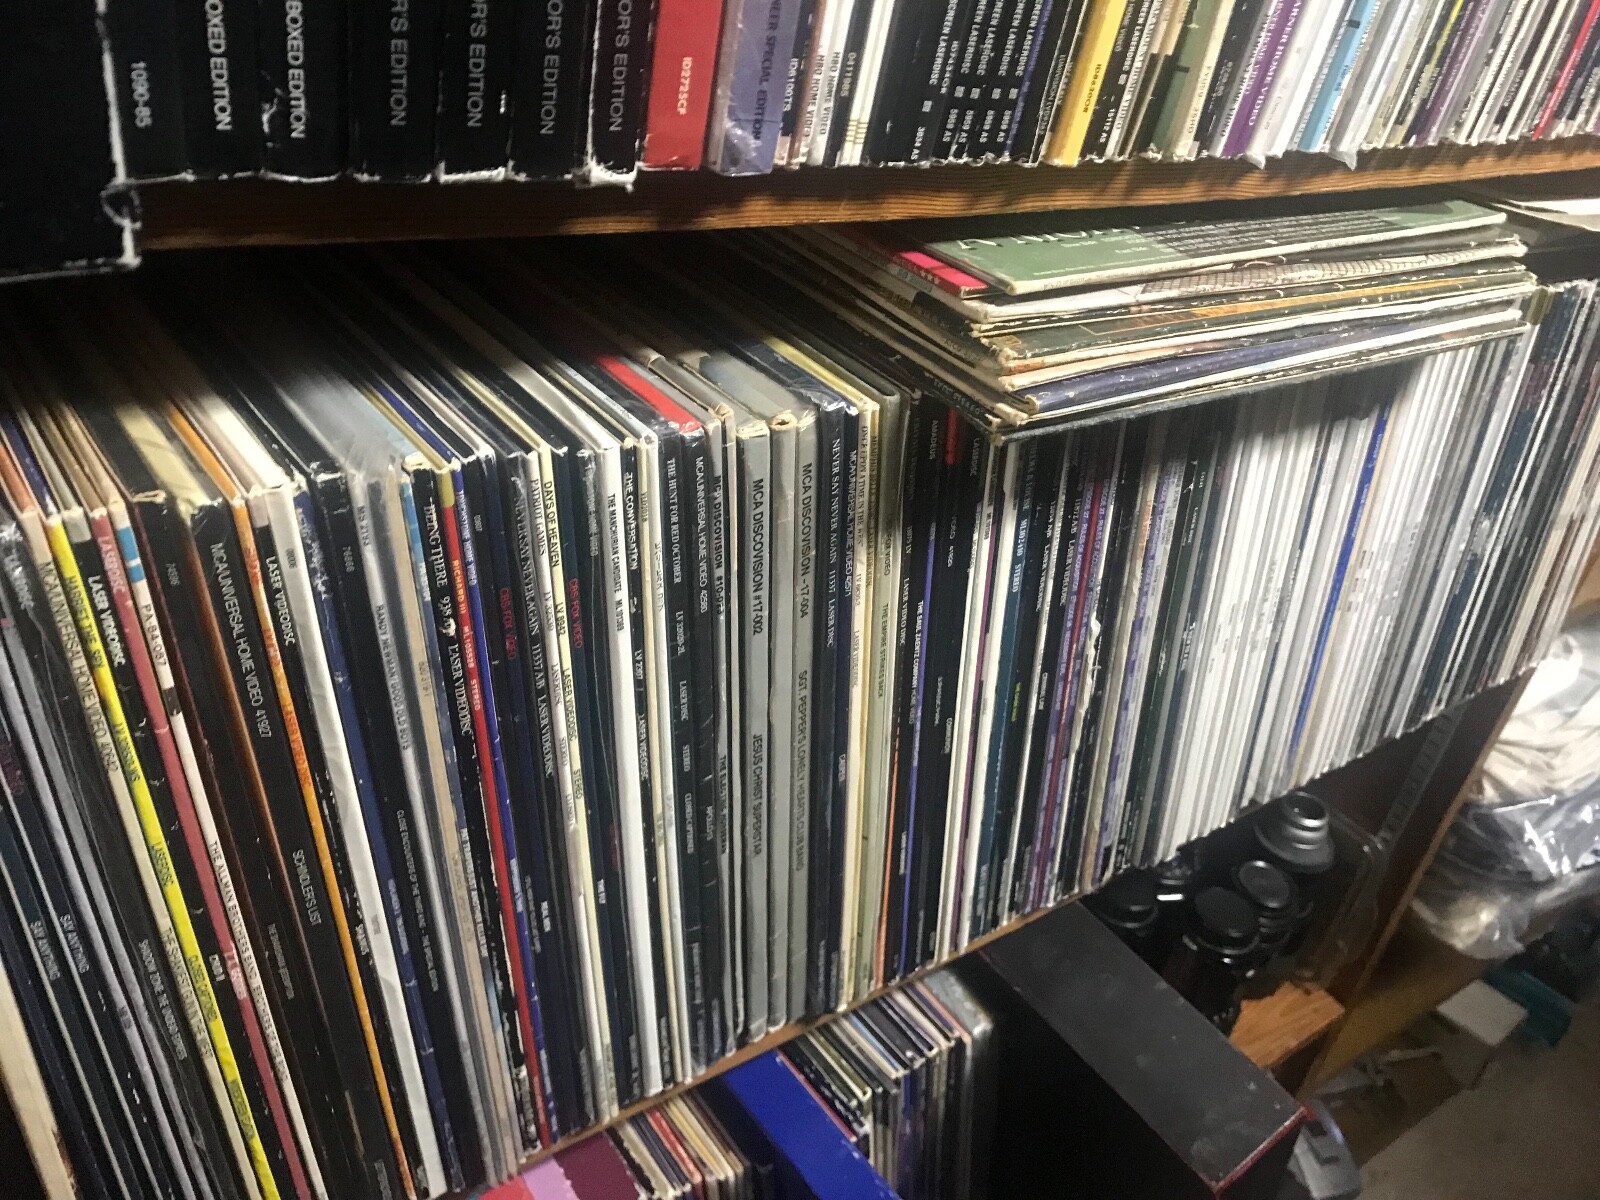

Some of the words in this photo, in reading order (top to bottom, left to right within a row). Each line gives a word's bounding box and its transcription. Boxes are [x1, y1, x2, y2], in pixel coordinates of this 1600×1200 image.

[285, 1, 304, 65] BOXED
[959, 22, 980, 74] LASERDISC
[1121, 24, 1143, 72] LASERDISC
[759, 33, 775, 86] SPECIAL
[813, 54, 825, 76] HBO
[829, 50, 841, 73] HBO
[928, 34, 950, 86] LASERDISC
[975, 25, 997, 76] LASERDISC
[996, 26, 1018, 77] LASERDISC
[1013, 26, 1035, 78] LASERDISC
[1262, 43, 1285, 86] HOME
[208, 54, 232, 130] EDITION
[389, 38, 407, 125] EDITION
[466, 42, 486, 127] EDITION
[539, 53, 558, 134] EDITION
[607, 51, 628, 132] EDITION
[807, 76, 821, 107] HOME
[824, 74, 837, 104] HOME
[288, 66, 306, 138] EDITION
[752, 87, 767, 139] EDITION
[1246, 84, 1269, 128] VIDEO
[818, 105, 831, 135] VIDEO
[832, 437, 841, 474] NEVER
[928, 419, 939, 460] AMADEUS
[969, 437, 980, 476] LASERDISC
[623, 471, 633, 493] THE
[666, 457, 677, 478] THE
[801, 462, 812, 495] MCA
[528, 477, 543, 521] PATRIOT
[542, 479, 554, 510] DAYS
[607, 492, 616, 508] THE
[668, 478, 677, 503] HUNT
[695, 455, 705, 532] MCA/UNIVERSAL
[752, 477, 763, 510] MCA
[831, 475, 840, 495] SAY
[857, 479, 865, 500] TIME
[546, 509, 557, 526] OF
[669, 504, 678, 523] FOR
[830, 495, 839, 530] NEVER
[856, 510, 864, 527] THE
[518, 537, 530, 561] SAY
[534, 520, 547, 557] GAMES
[547, 525, 562, 568] HEAVEN
[607, 508, 619, 556] MANCHURIAN
[624, 493, 637, 571] CONVERSATION
[670, 523, 679, 543] RED
[697, 531, 706, 559] HOME
[712, 501, 723, 569] DISCOVISION
[800, 495, 812, 576] DISCOVISION
[829, 531, 838, 564] AGAIN
[429, 544, 447, 589] THERE
[462, 538, 476, 563] HOME
[671, 543, 682, 584] OCTOBER
[752, 510, 763, 592] DISCOVISION
[845, 549, 854, 575] VIDEO
[884, 549, 892, 576] VIDEO
[208, 540, 246, 639] MCA/UNIVERSAL
[264, 554, 283, 591] LASER
[466, 562, 480, 586] VIDEO
[521, 559, 535, 602] NEVER
[610, 555, 622, 594] CANDIDATE
[698, 559, 707, 587] VIDEO
[828, 568, 837, 593] 11337
[901, 577, 909, 602] LASER
[1011, 561, 1023, 594] STEREO
[86, 573, 109, 611] LASER
[99, 609, 127, 668] VIDEODISC
[272, 589, 296, 647] VIDEODISC
[373, 603, 389, 637] RANDY
[525, 599, 539, 637] AGAIN
[752, 593, 762, 636] #17-002
[827, 597, 836, 627] LASER
[881, 602, 889, 620] THE
[899, 602, 907, 628] VIDEO
[914, 614, 922, 632] SAUL
[915, 599, 924, 614] THE
[80, 622, 98, 647] THE
[449, 558, 465, 602] RICHARD
[470, 676, 482, 712] STEREO
[826, 625, 835, 648] DISC
[898, 627, 906, 647] DISC
[912, 632, 921, 659] ZAENTZ
[233, 635, 255, 673] HOME
[446, 644, 463, 680] LASER
[878, 647, 886, 679] STRIKES
[243, 670, 265, 708] VIDEO
[561, 667, 574, 697] LASER
[678, 680, 687, 703] LASER
[877, 677, 885, 698] BACK
[452, 678, 473, 737] VIDEODISC
[536, 694, 550, 727] LASER
[565, 696, 578, 742] VIDEODISC
[680, 703, 688, 721] DISC
[637, 712, 646, 740] LASER
[540, 726, 554, 778] VIDEODISC
[638, 739, 648, 781] VIDEODISC
[682, 743, 690, 772] STEREO
[753, 733, 763, 766] JESUS
[572, 766, 584, 800] STEREO
[752, 765, 763, 800] CHRIST
[752, 800, 761, 856] SUPERSTAR
[207, 839, 222, 863] THE
